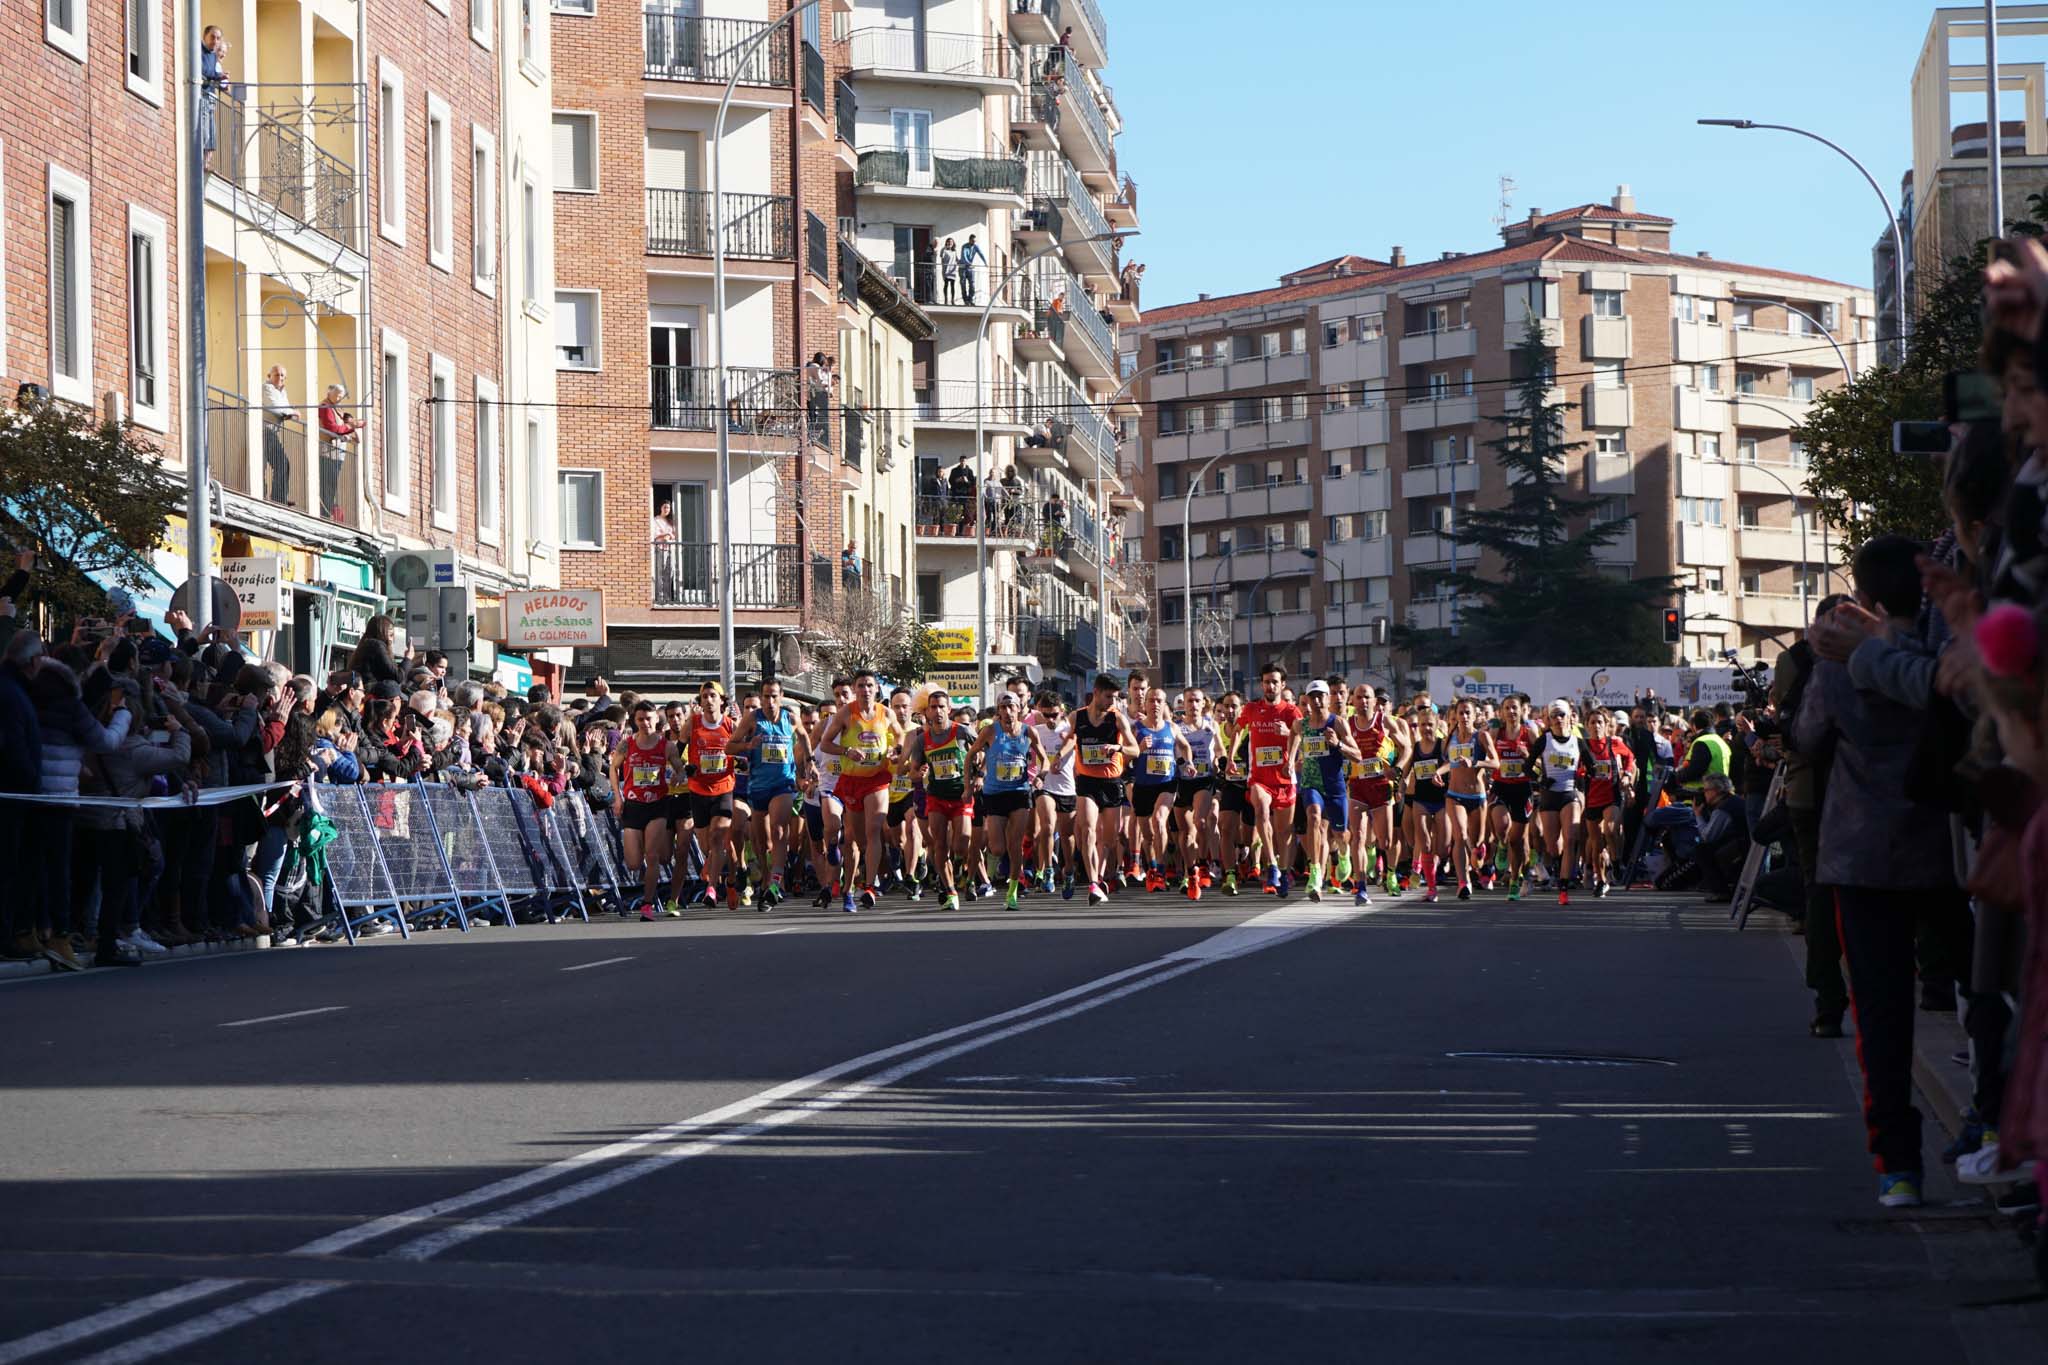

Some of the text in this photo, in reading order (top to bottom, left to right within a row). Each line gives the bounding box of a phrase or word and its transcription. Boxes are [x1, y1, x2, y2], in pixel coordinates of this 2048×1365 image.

[524, 595, 588, 615] HELADOS
[246, 618, 271, 626] Kodak
[519, 615, 593, 627] Arte-Sanos
[524, 631, 587, 641] LA COLMENA
